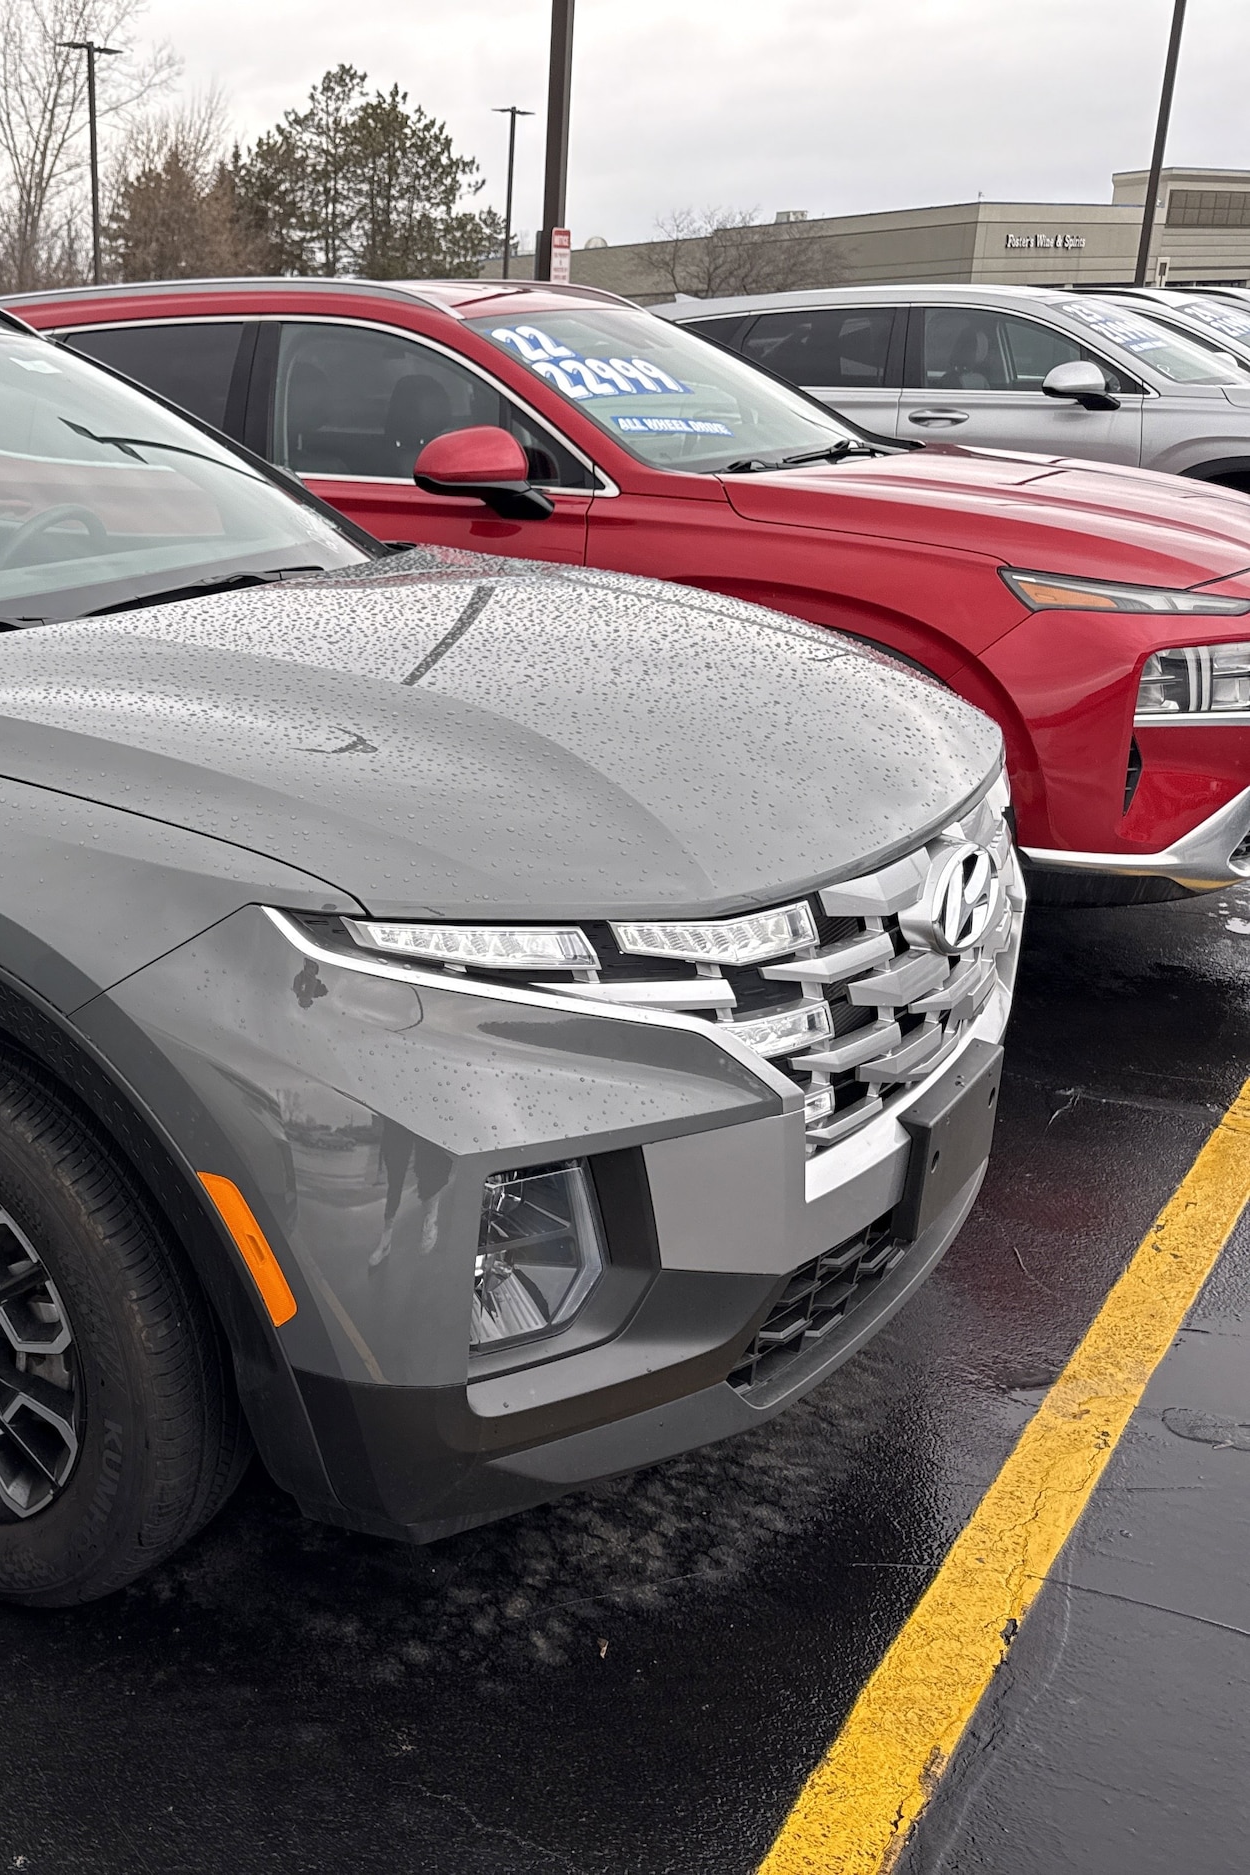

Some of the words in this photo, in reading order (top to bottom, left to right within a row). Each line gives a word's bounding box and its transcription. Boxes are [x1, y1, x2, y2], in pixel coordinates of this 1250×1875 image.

[1007, 233, 1035, 248] Foster's
[1036, 233, 1055, 248] Wine
[1056, 234, 1063, 248] &
[1064, 234, 1087, 251] Spirits
[491, 326, 575, 361] 22
[532, 358, 684, 398] 22999
[618, 418, 649, 431] ALL
[642, 418, 694, 432] WHEEL
[687, 420, 732, 435] DRIVE
[71, 1418, 124, 1549] KUMHO
